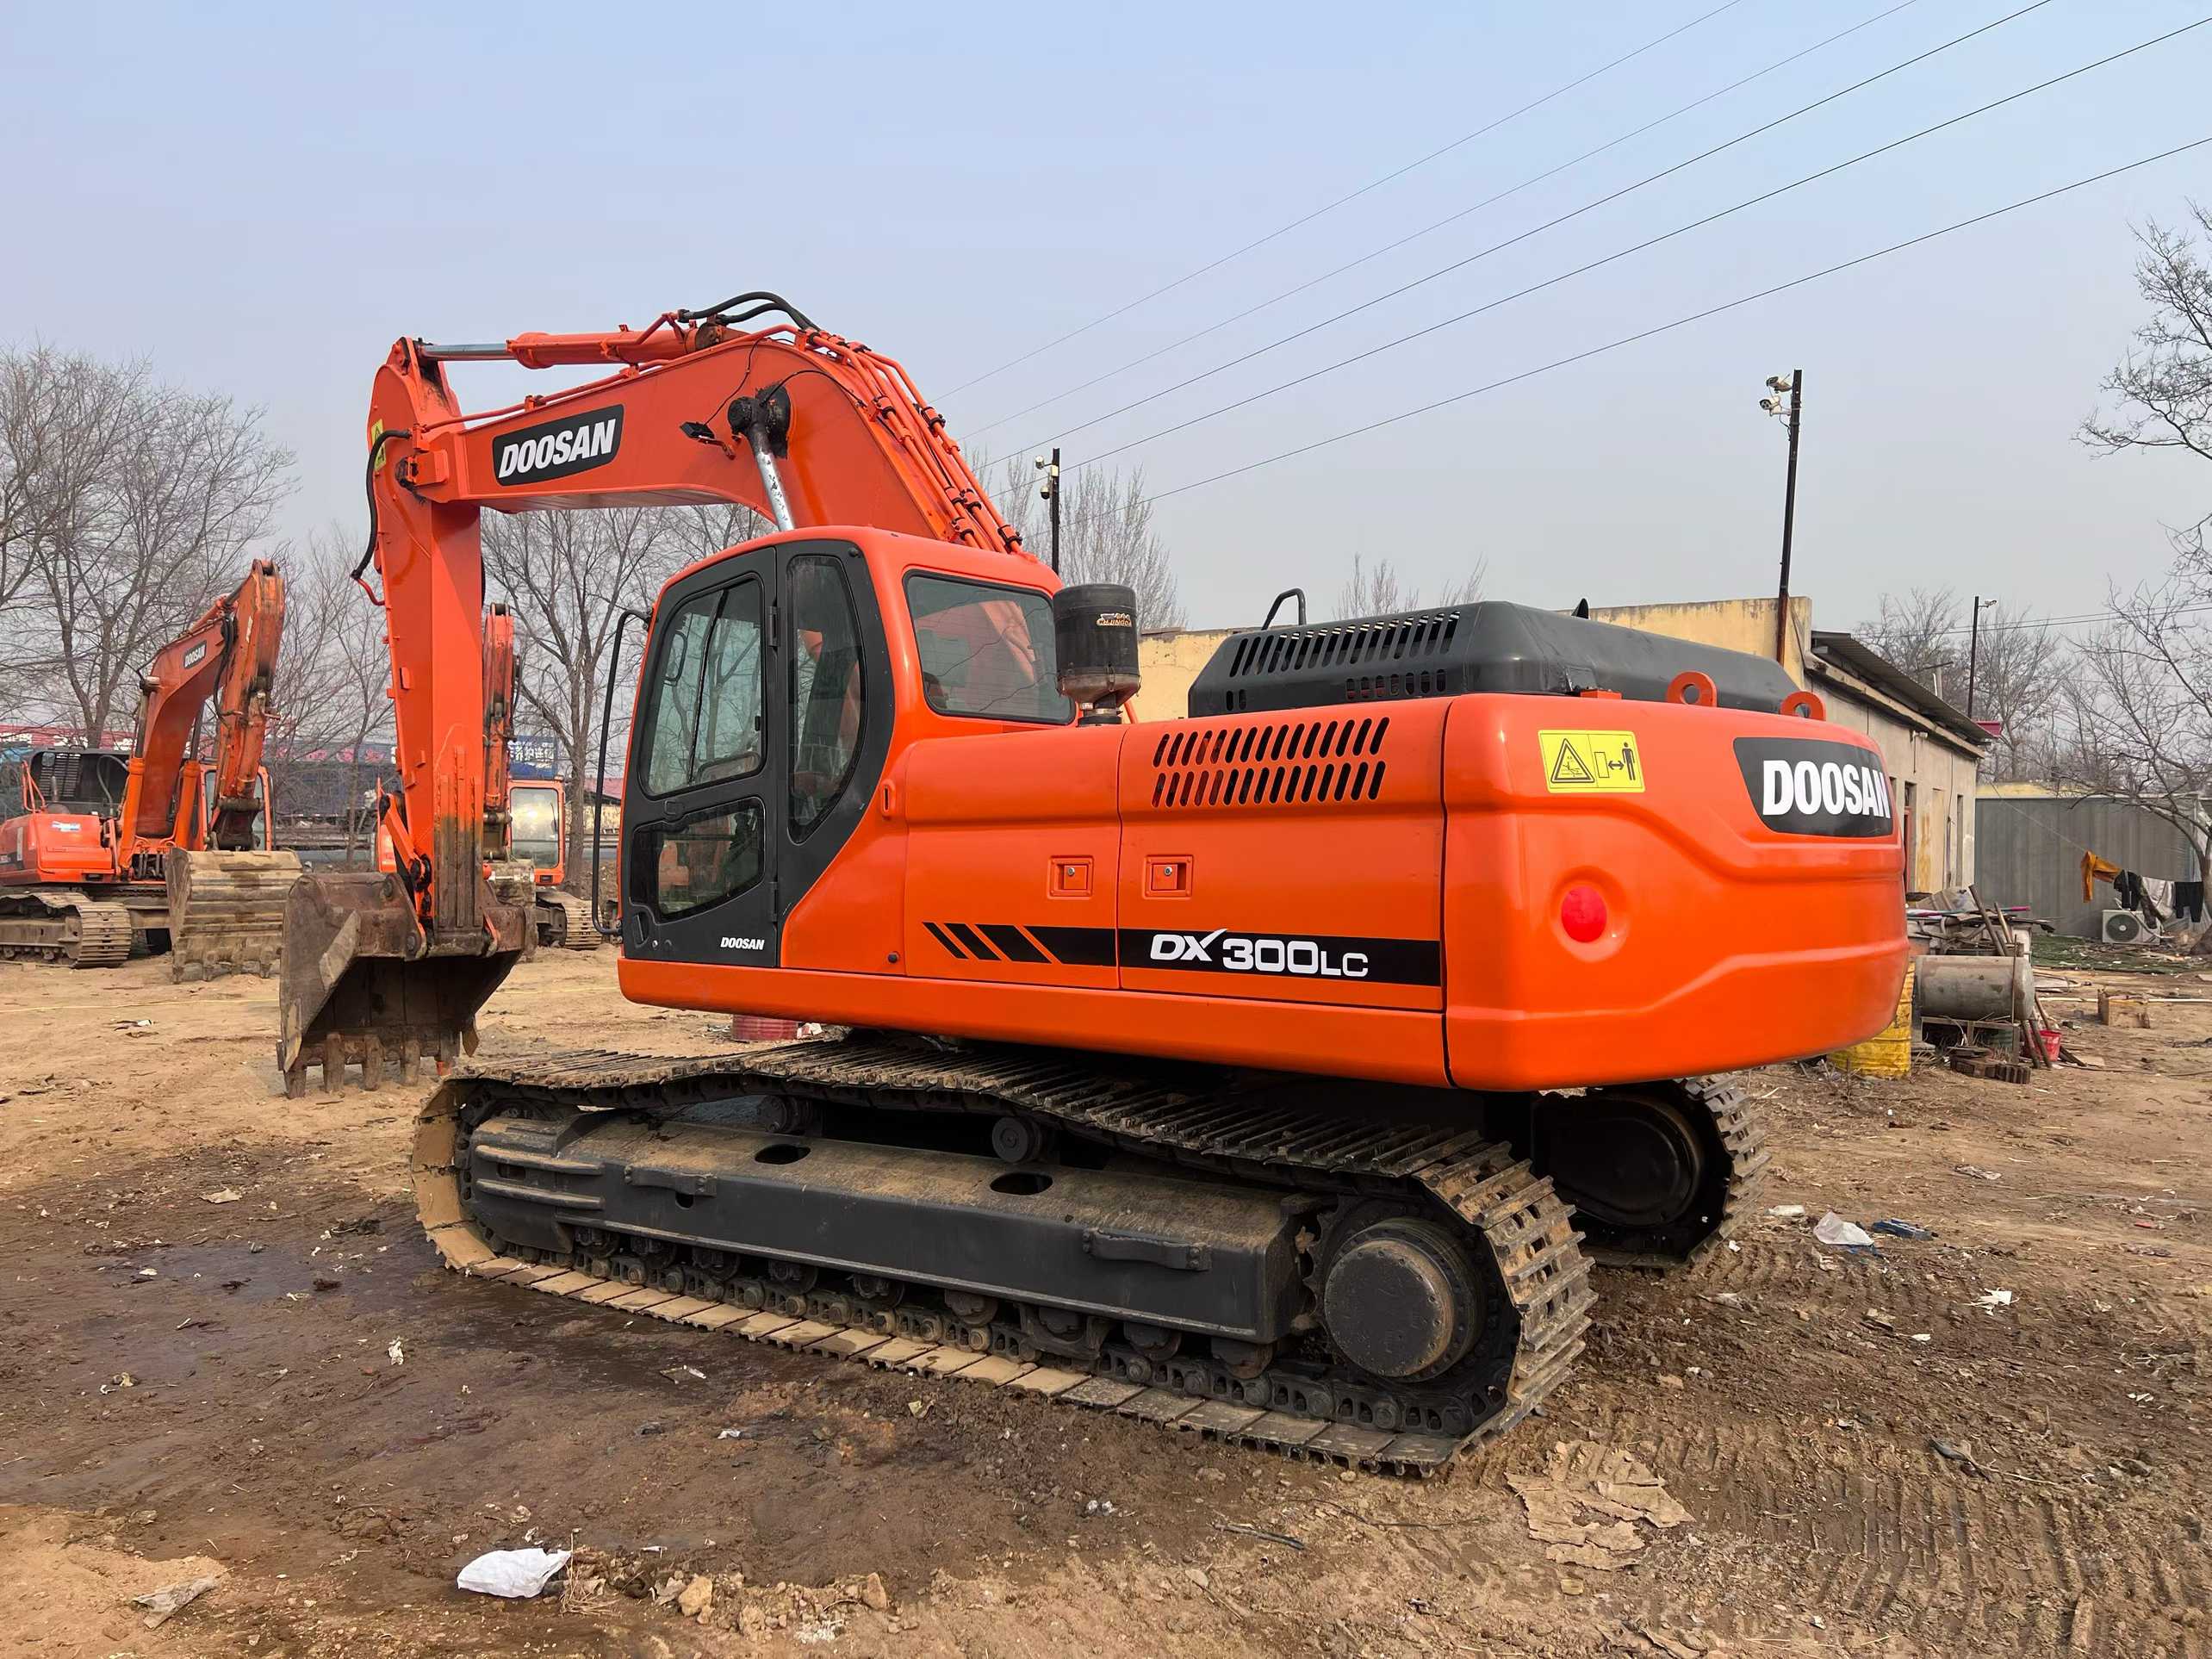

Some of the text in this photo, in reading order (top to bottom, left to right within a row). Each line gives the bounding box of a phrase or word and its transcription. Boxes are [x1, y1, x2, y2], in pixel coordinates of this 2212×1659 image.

[498, 419, 616, 478] DOOSAN
[184, 644, 206, 668] DOOSAN
[1762, 760, 1891, 819] DOOSAN
[720, 936, 765, 950] DOOSAN
